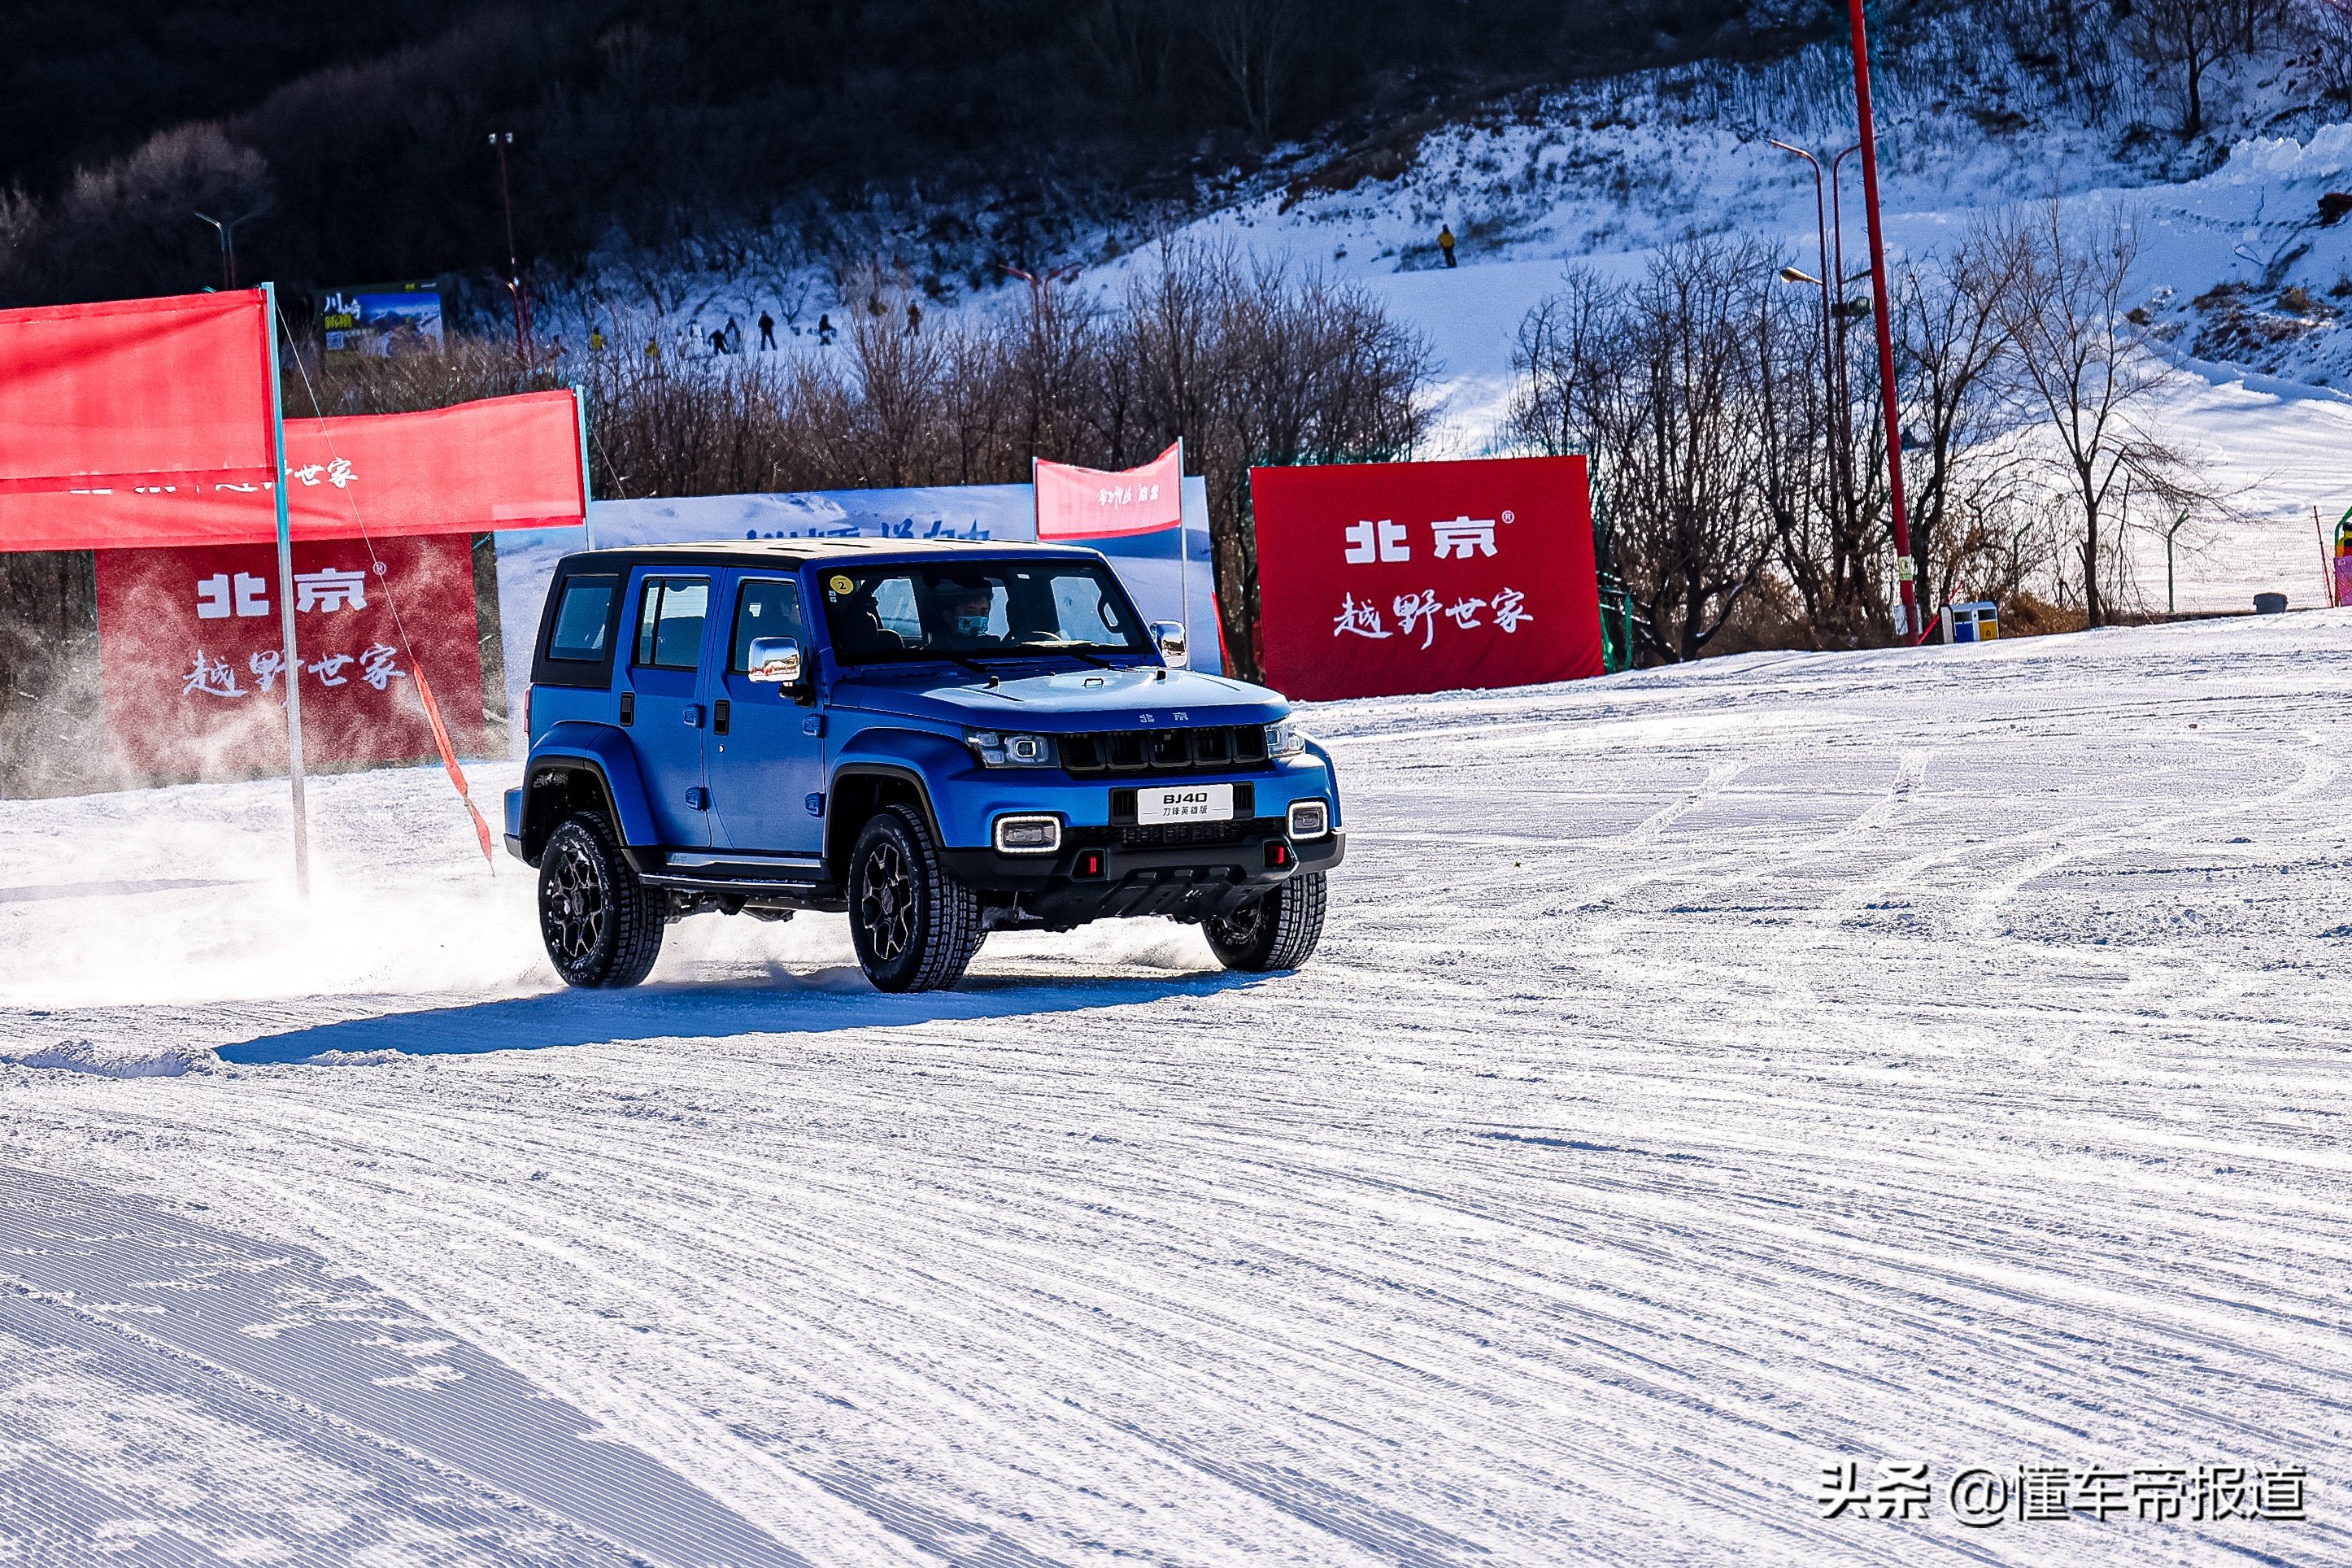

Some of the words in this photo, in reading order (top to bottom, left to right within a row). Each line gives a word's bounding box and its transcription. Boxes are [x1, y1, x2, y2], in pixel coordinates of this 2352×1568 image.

[838, 581, 847, 590] 2
[1334, 587, 1534, 650] 越野世家
[183, 642, 407, 706] 越野世家
[1139, 712, 1189, 723] 北京
[1163, 792, 1208, 804] BJ40
[1162, 804, 1208, 817] 刀锋英雄版
